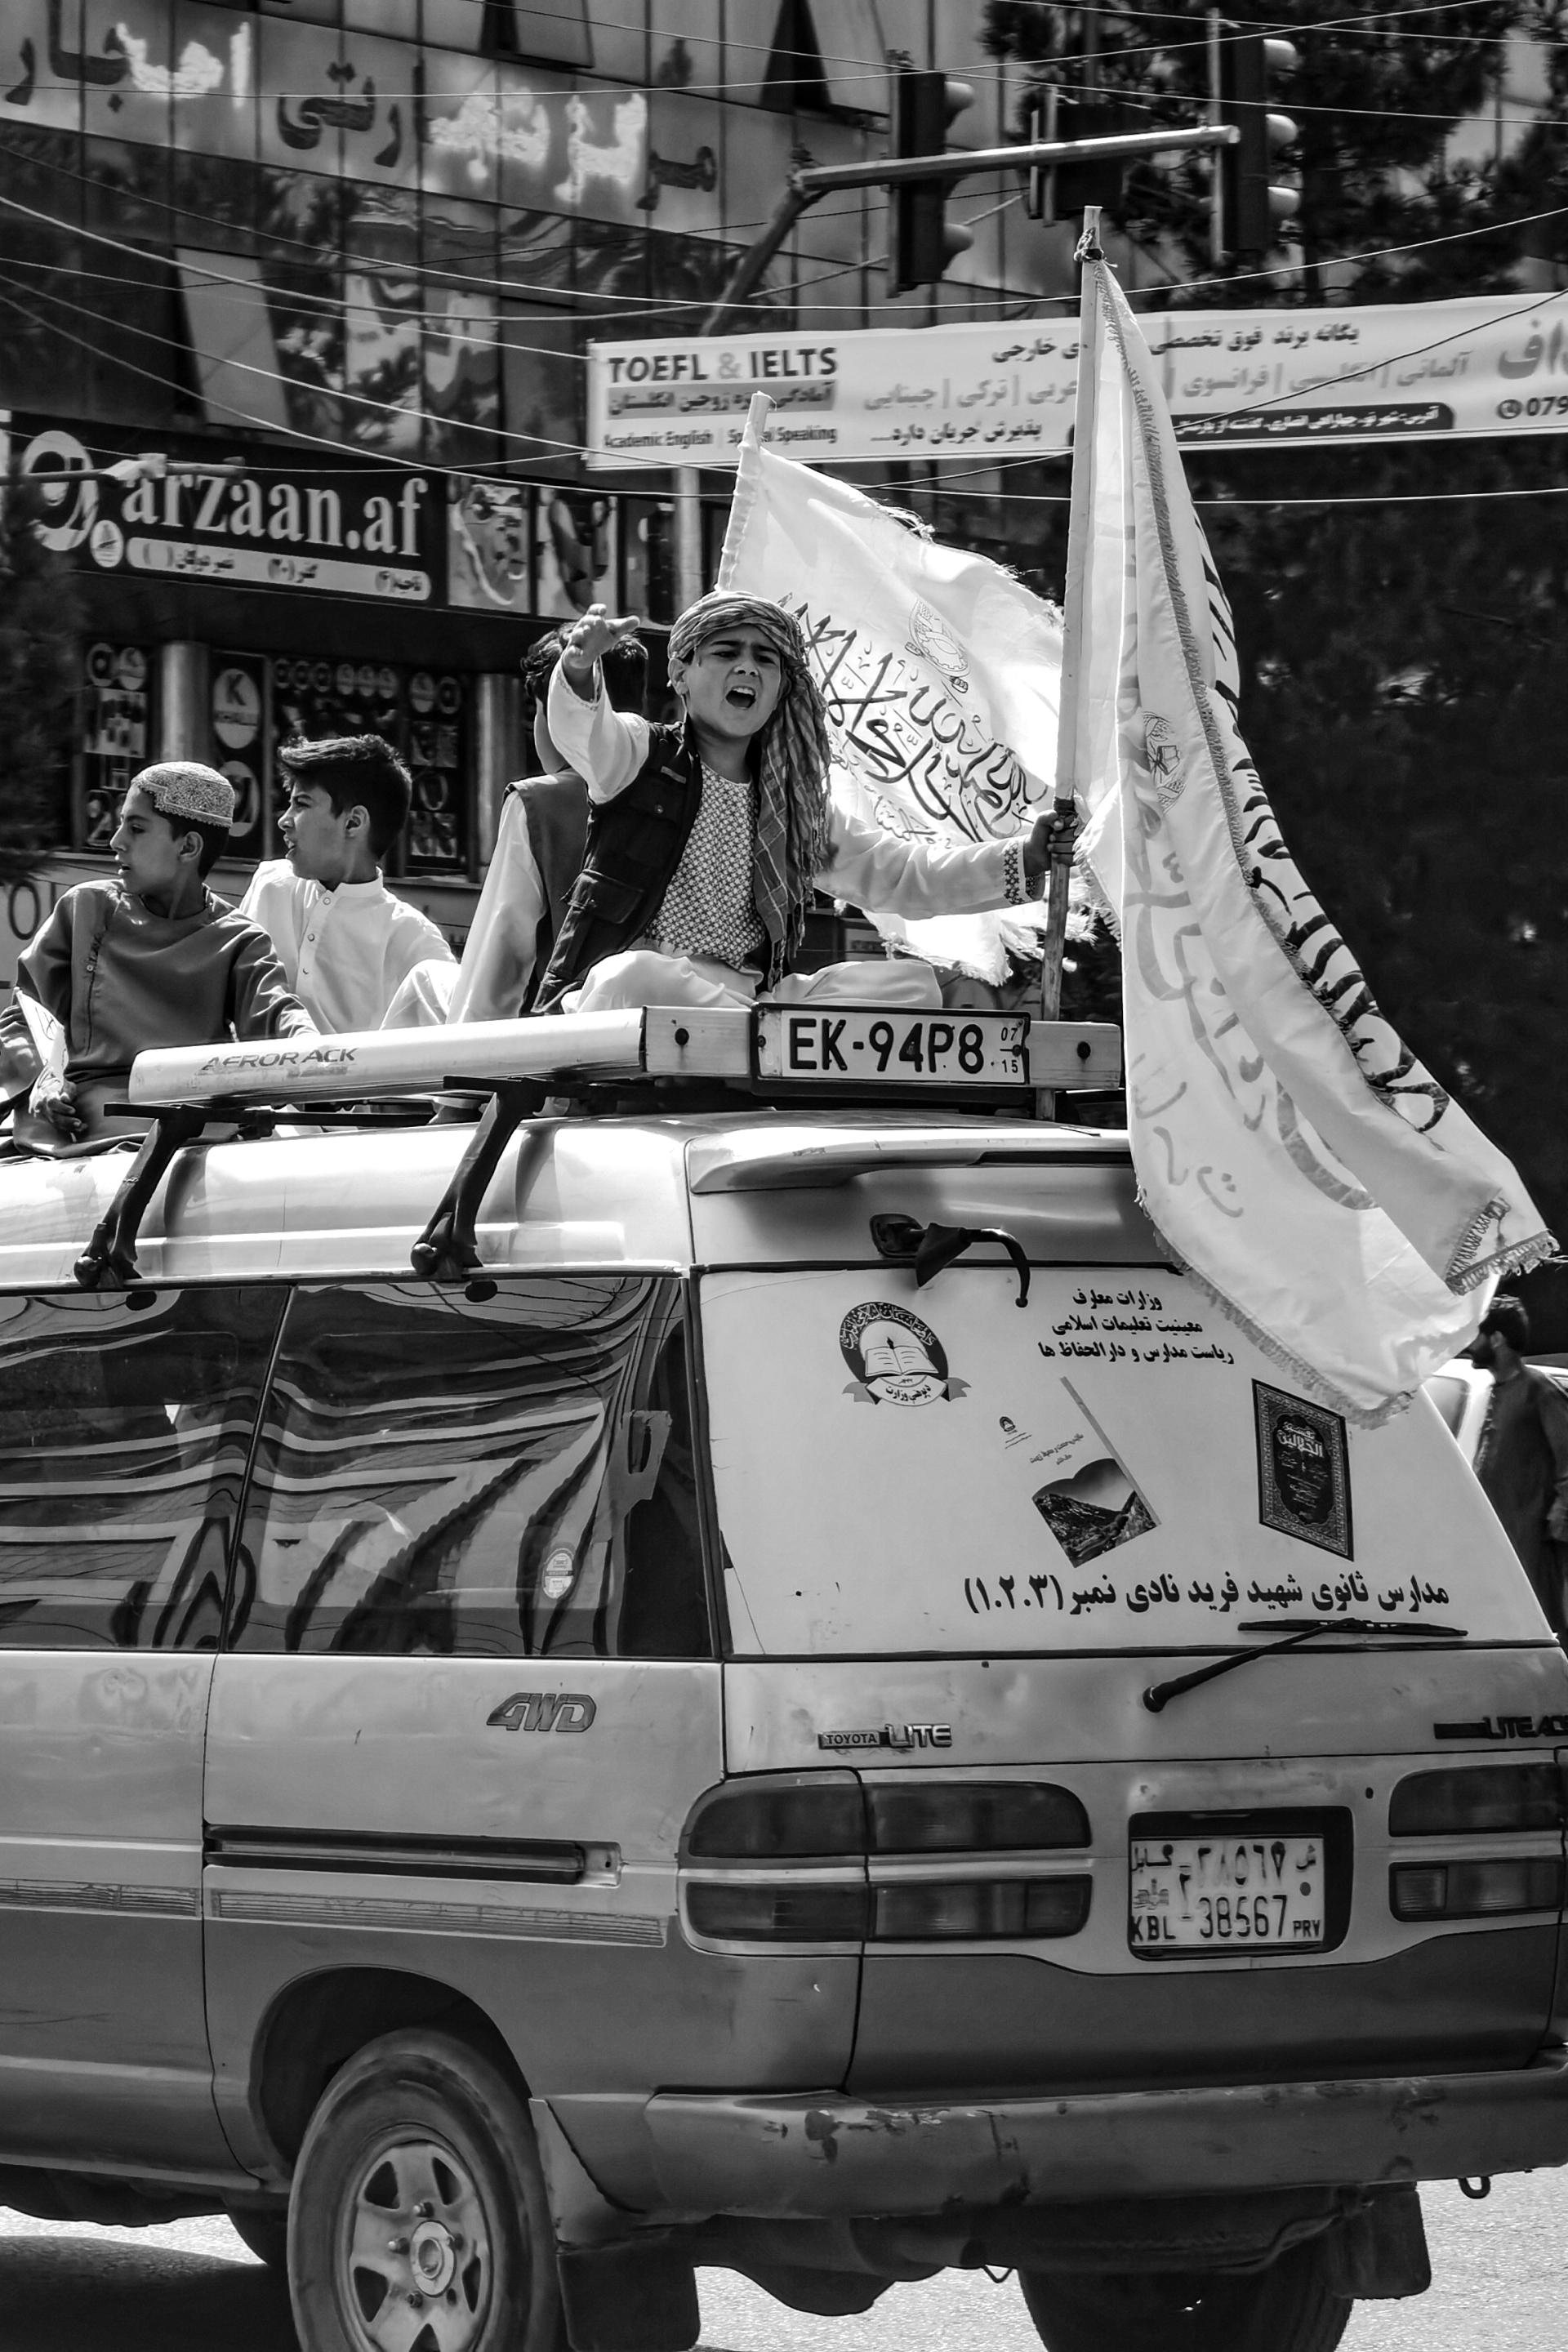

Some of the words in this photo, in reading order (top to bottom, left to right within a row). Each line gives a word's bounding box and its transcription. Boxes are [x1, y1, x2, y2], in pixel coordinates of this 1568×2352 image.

[608, 354, 708, 384] TOEFL
[718, 352, 742, 380] &
[750, 346, 837, 379] IELTS
[122, 476, 428, 557] arzaan.af
[788, 1018, 985, 1075] EK-94P8
[1000, 1026, 1019, 1042] 07
[1000, 1058, 1019, 1074] 15
[1052, 1314, 1098, 1336] اسلامی
[1101, 1315, 1152, 1335] تعلیمات
[1037, 1342, 1056, 1357] ها
[1143, 1343, 1188, 1363] مدارس
[1191, 1343, 1235, 1365] ریاست
[1069, 1574, 1116, 1615] نمبر
[1125, 1573, 1180, 1613] نادی
[1187, 1571, 1240, 1613] فرید
[1247, 1574, 1303, 1608] شهید
[1312, 1570, 1370, 1612] ثانوی
[1377, 1575, 1450, 1613] مدارس
[487, 1692, 597, 1732] 4WD
[826, 1732, 878, 1745] TOYOTA
[884, 1723, 953, 1748] LITE
[1131, 1914, 1177, 1942] KBL
[1196, 1894, 1288, 1939] 38567
